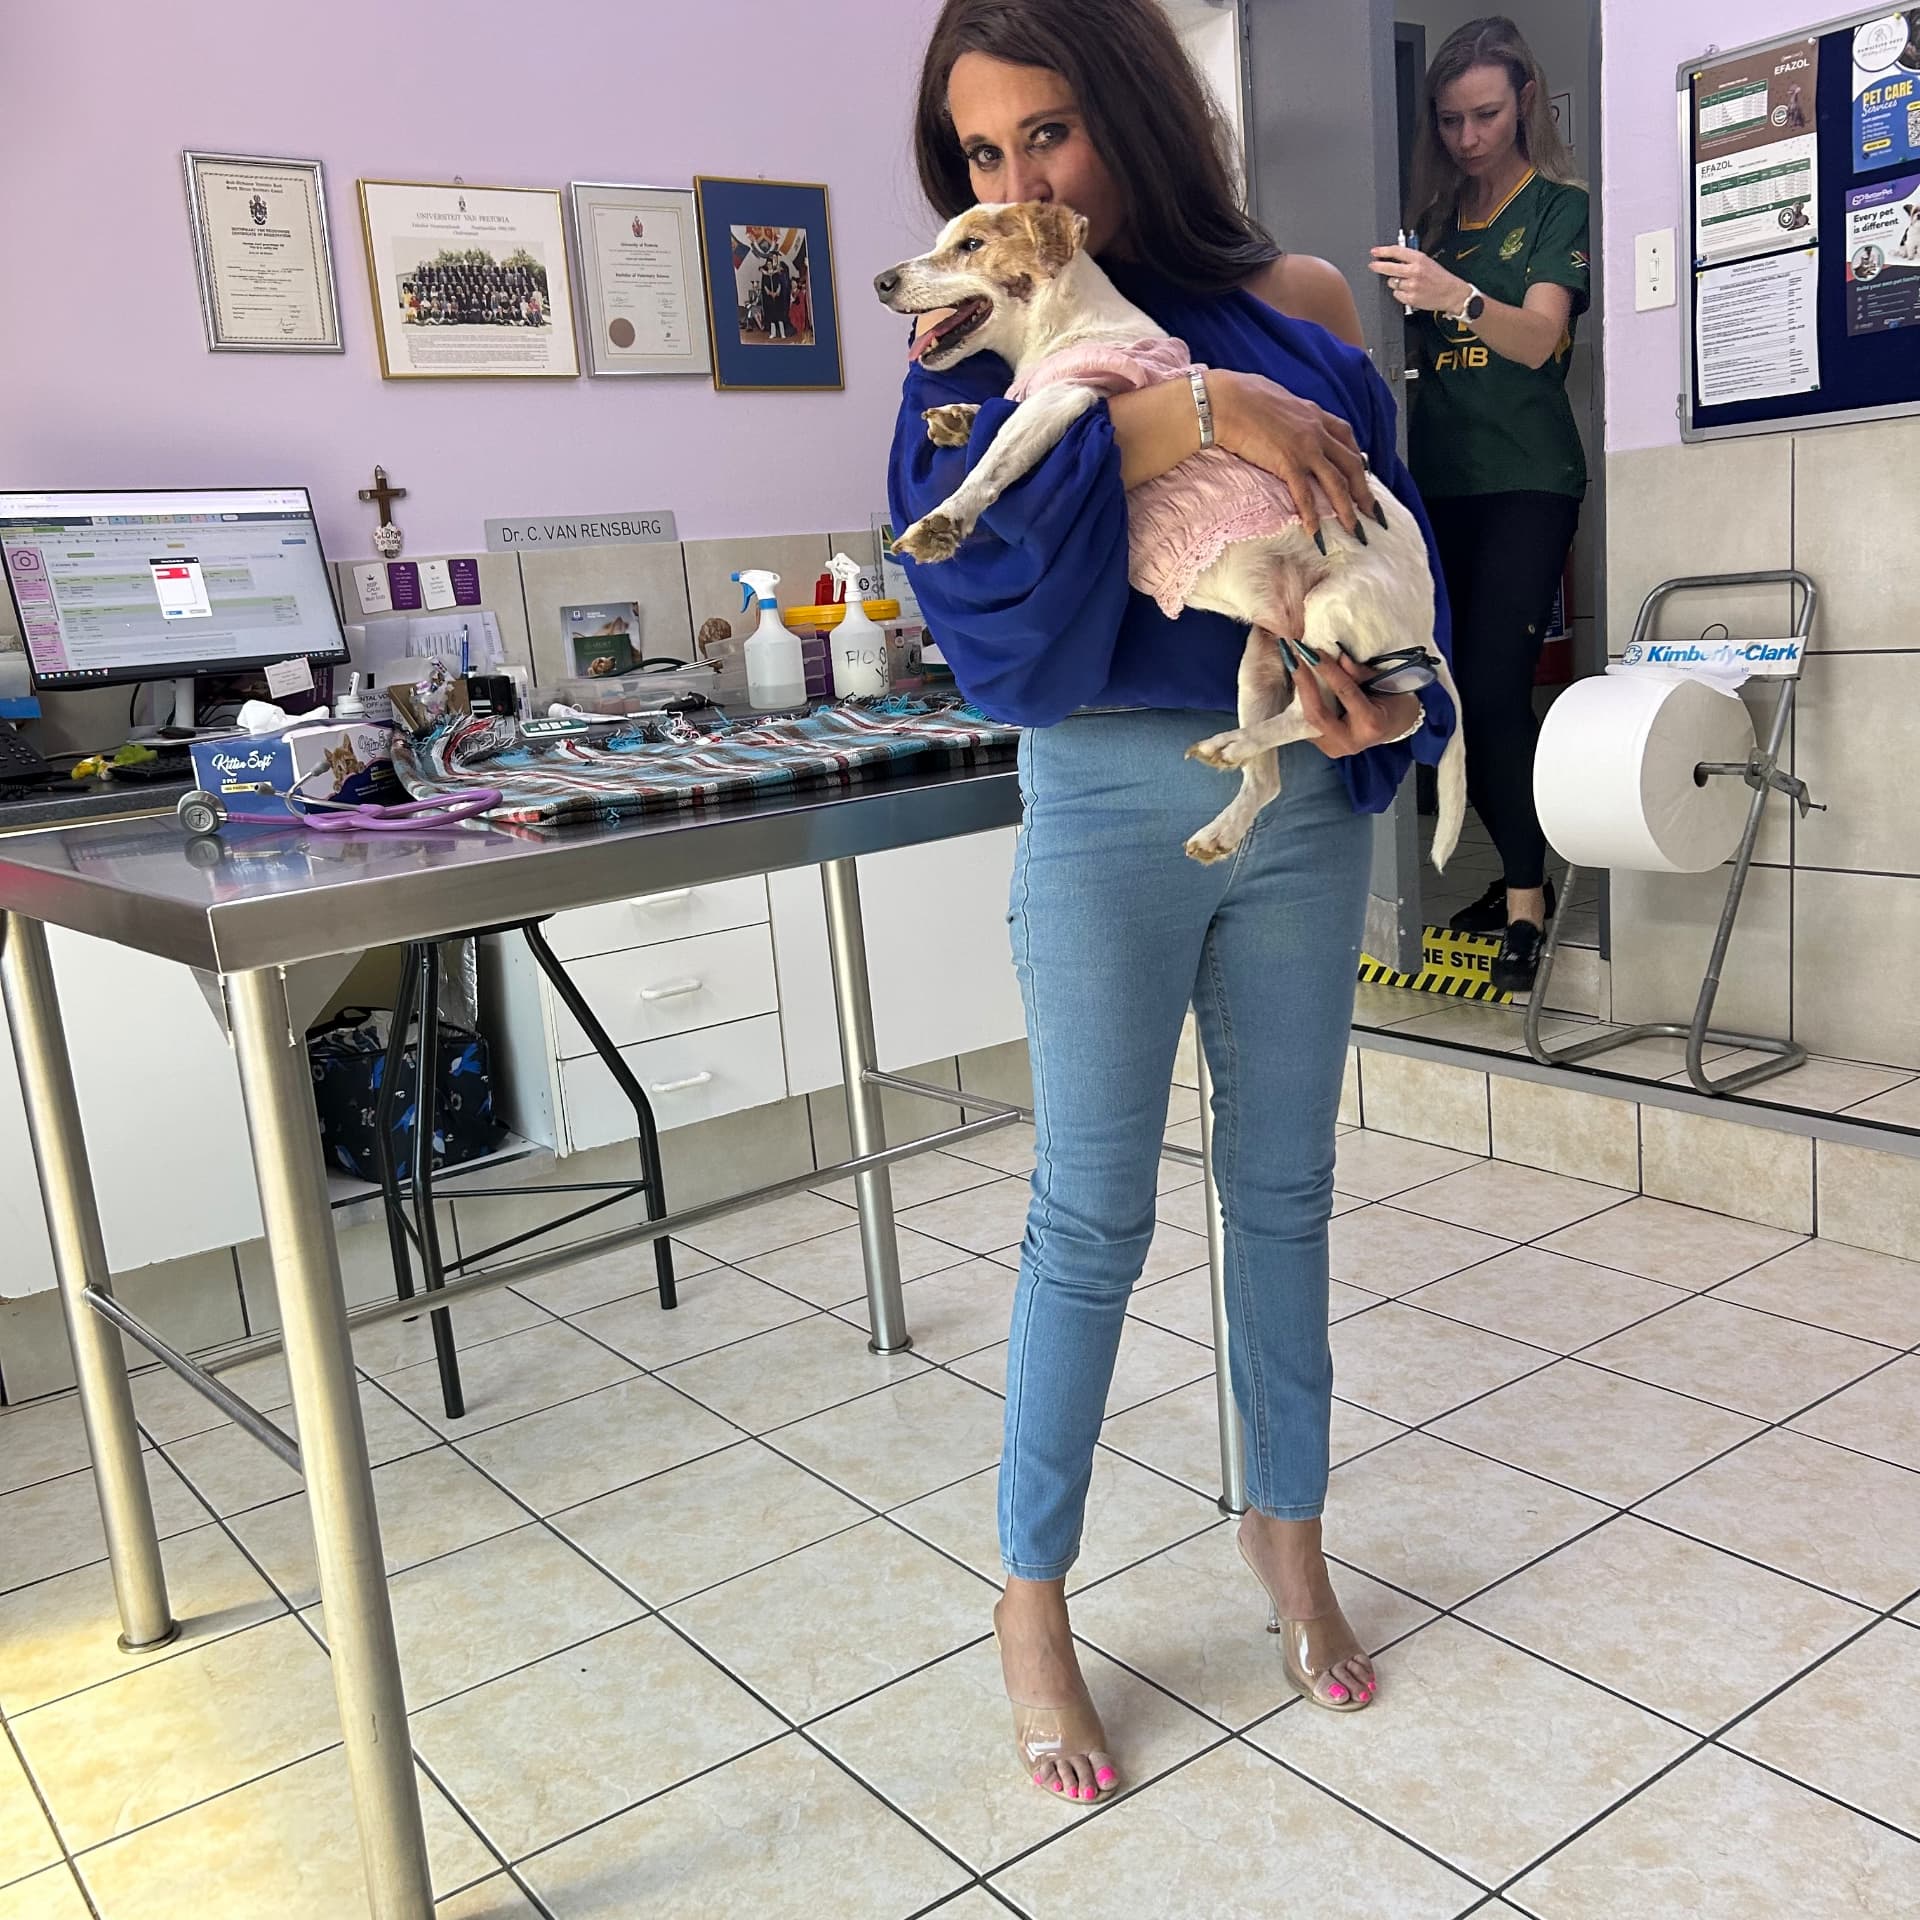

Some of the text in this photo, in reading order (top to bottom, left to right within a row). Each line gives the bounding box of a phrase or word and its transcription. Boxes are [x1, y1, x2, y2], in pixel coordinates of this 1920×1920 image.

[1774, 58, 1810, 75] EFAZOL
[1863, 80, 1913, 105] PET CARE
[1861, 100, 1898, 117] Services
[1701, 160, 1733, 175] EFAZOL
[1853, 208, 1894, 223] Every pet
[1853, 218, 1899, 233] is different
[1435, 346, 1488, 370] FNB
[502, 520, 661, 542] Dr. C. VAN RENSBURG
[211, 750, 274, 777] Kitten Soft
[1423, 948, 1444, 966] HE
